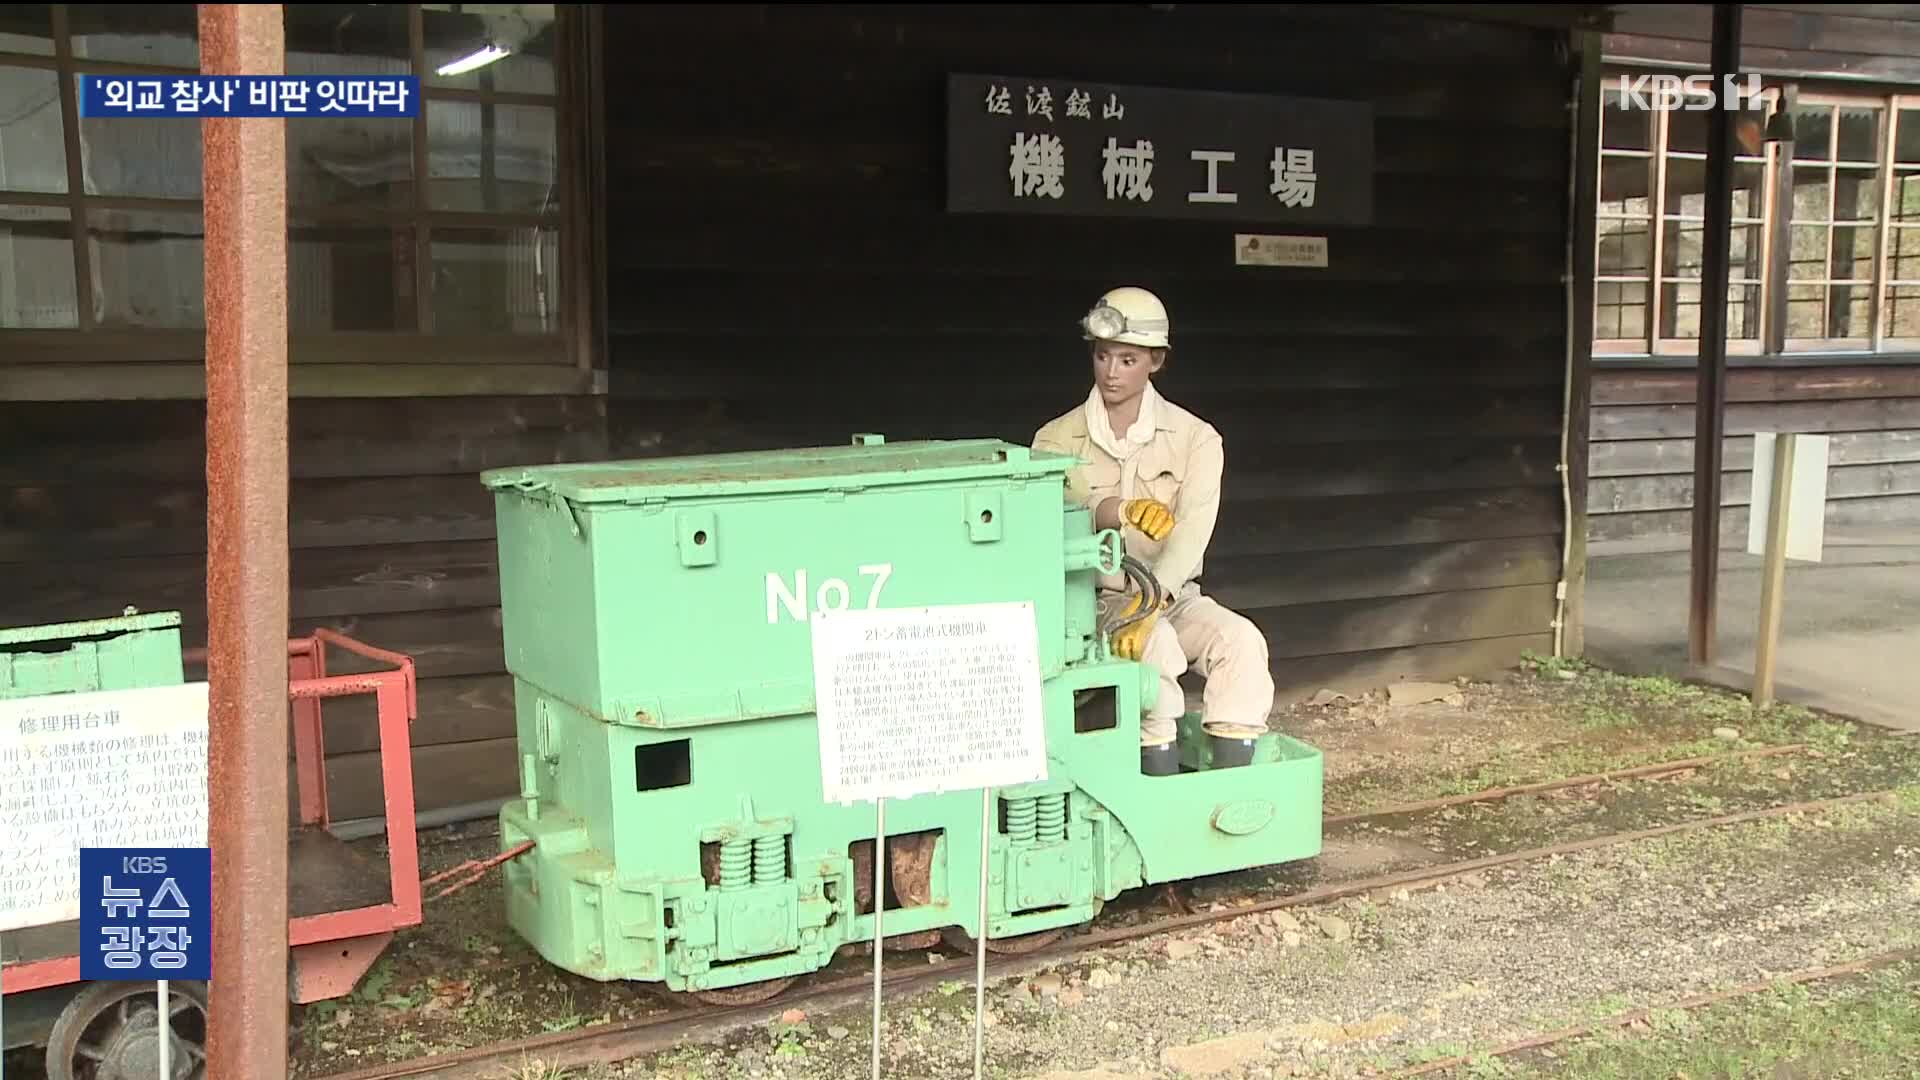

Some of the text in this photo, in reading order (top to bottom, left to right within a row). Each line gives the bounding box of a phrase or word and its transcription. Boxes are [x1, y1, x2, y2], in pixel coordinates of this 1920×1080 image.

[1009, 131, 1317, 208] 機械工場
[17, 709, 121, 736] 修理用台車
